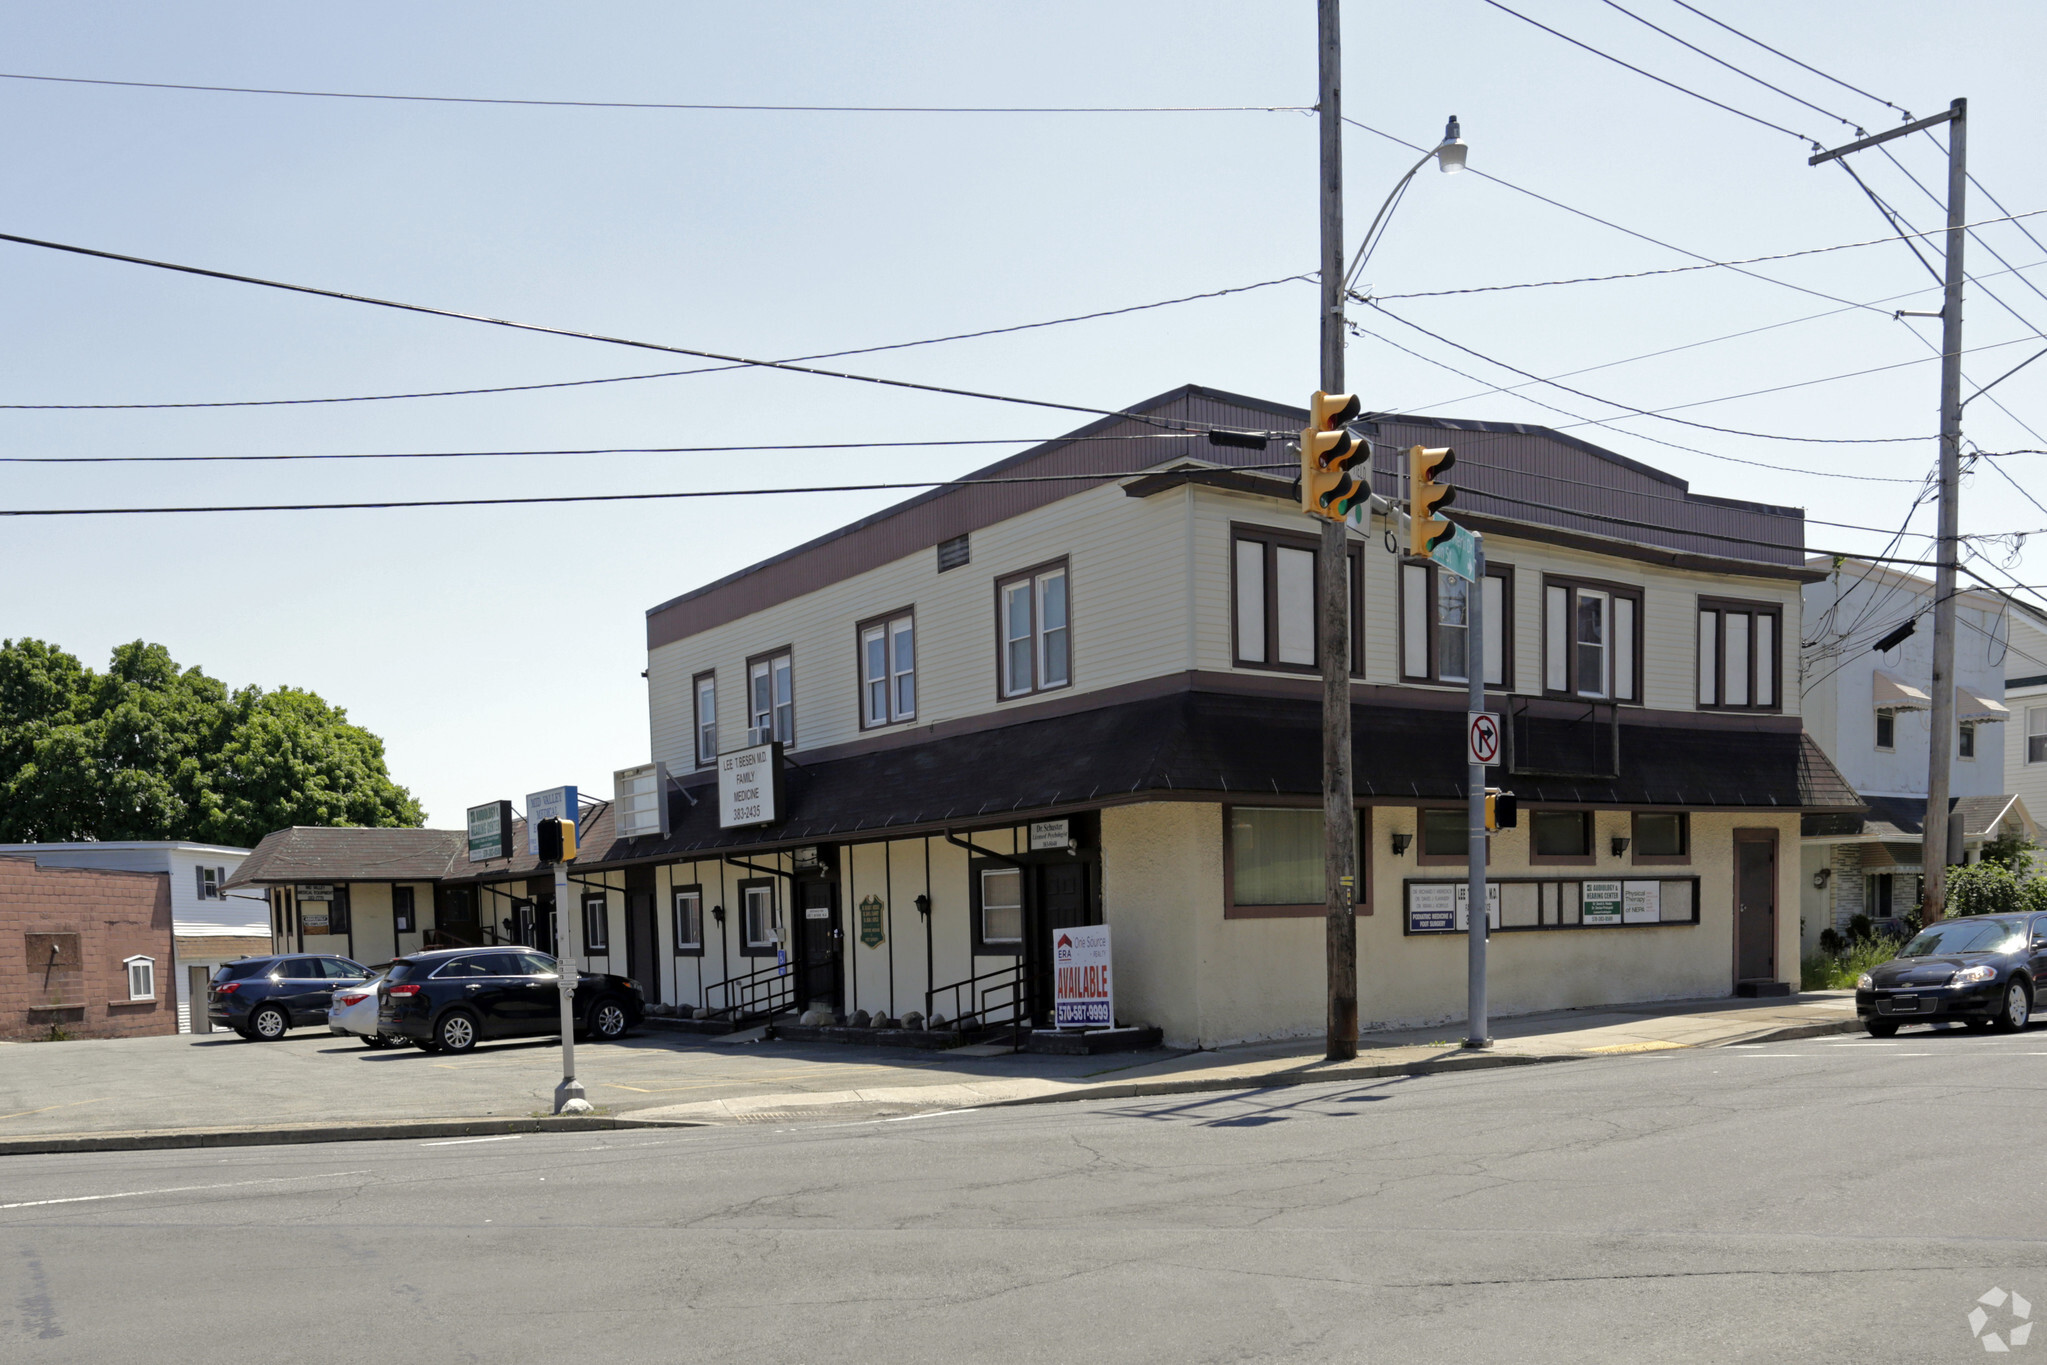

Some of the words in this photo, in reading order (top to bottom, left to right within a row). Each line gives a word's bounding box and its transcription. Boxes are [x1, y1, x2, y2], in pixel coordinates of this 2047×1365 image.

[723, 759, 733, 771] LEE
[736, 771, 755, 785] FAMILY
[531, 797, 541, 808] MID
[543, 792, 562, 805] VALLEY
[734, 787, 759, 803] MEDICINE
[536, 806, 558, 819] MEDICAL
[733, 805, 760, 821] 383-2435
[1043, 823, 1064, 832] Schuster
[1458, 888, 1466, 900] LEE
[1074, 937, 1086, 949] One
[1086, 936, 1106, 949] Source
[1058, 949, 1072, 958] ERA
[1093, 950, 1106, 958] REALTY
[1058, 965, 1108, 999] AVAILABLE
[1058, 1003, 1109, 1021] 570-587-9999
